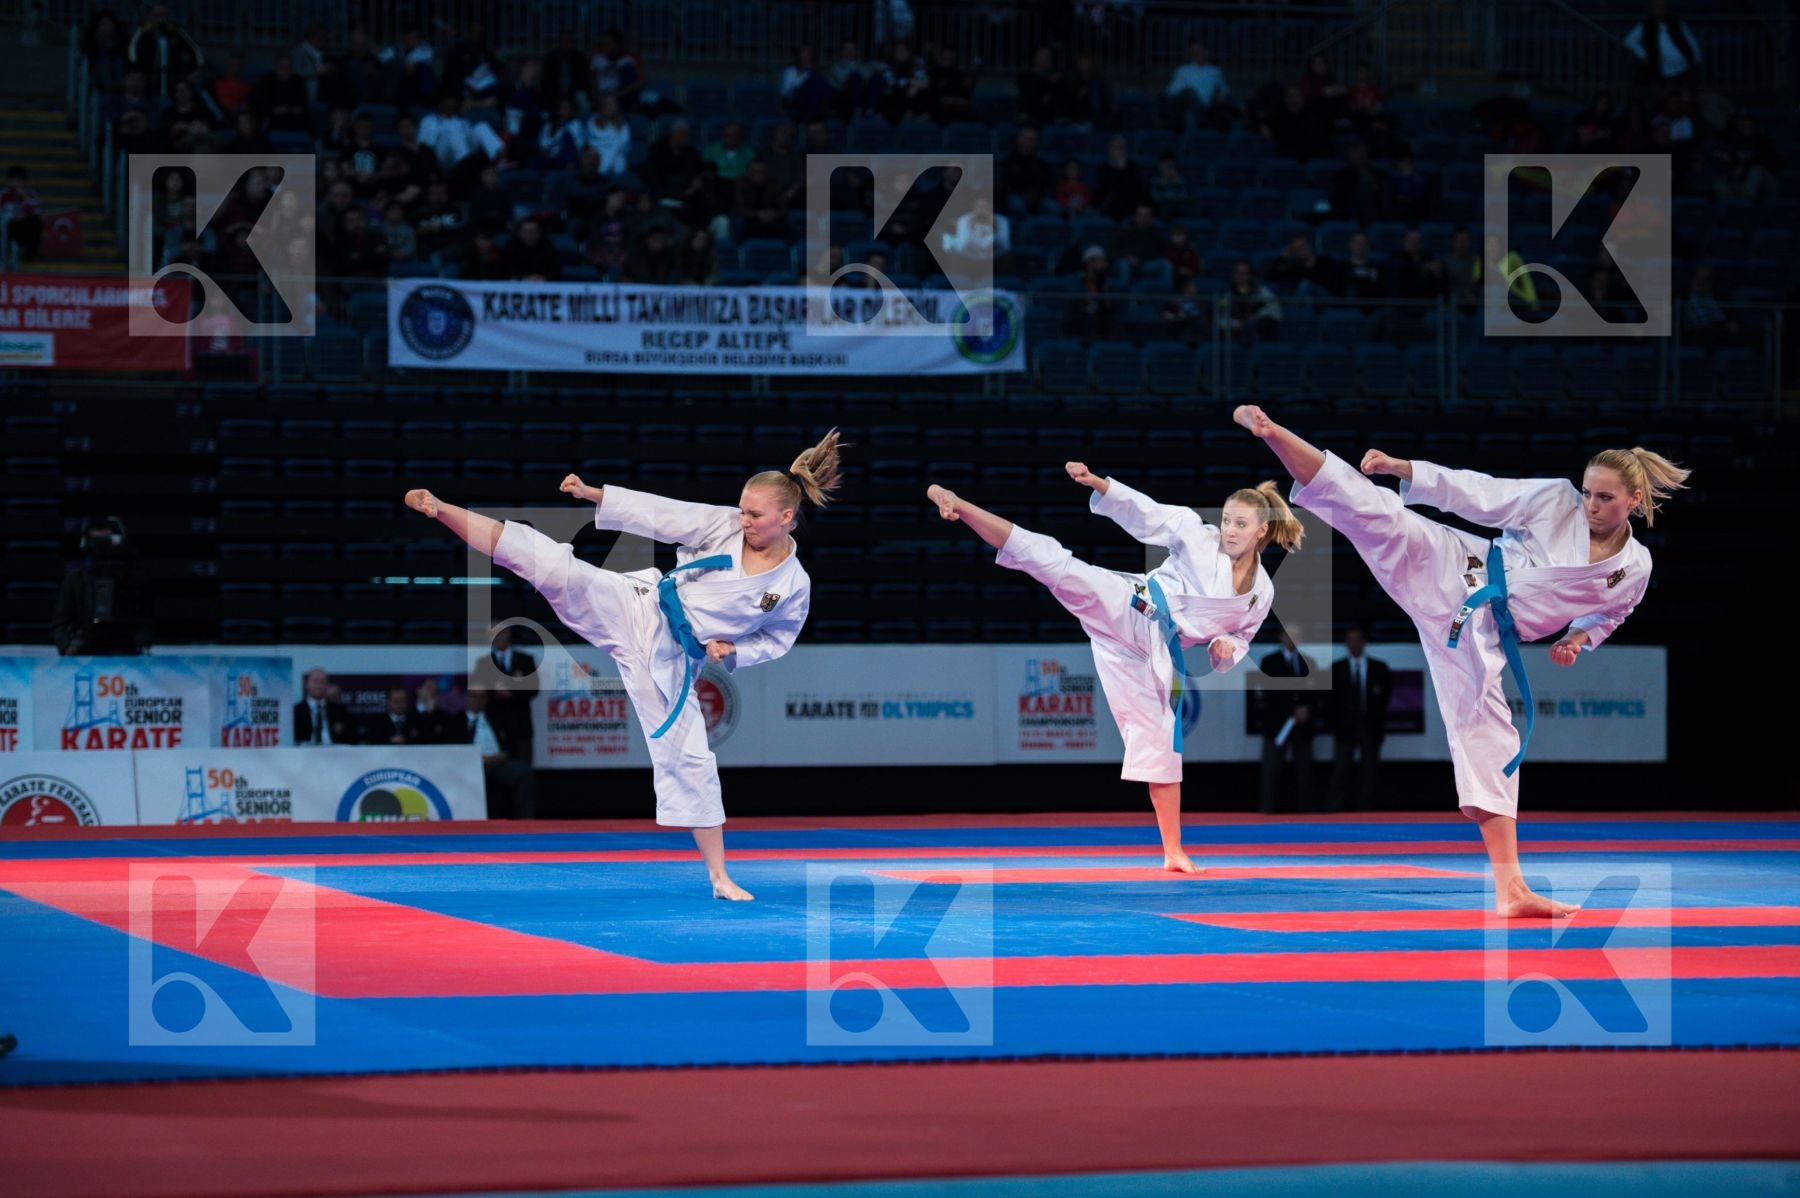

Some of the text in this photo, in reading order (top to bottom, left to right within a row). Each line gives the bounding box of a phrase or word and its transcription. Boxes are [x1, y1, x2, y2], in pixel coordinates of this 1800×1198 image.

[482, 292, 562, 321] KARATE
[568, 286, 619, 322] MİLLİ
[626, 294, 741, 324] TAKIMIMIZA
[24, 306, 92, 330] DİLERİZ
[641, 331, 790, 350] RECEP ALTEPE
[585, 352, 630, 365] BURSA
[125, 698, 182, 707] EUROPEAN
[548, 698, 628, 719] KARATE
[786, 701, 855, 718] KARATE
[882, 701, 975, 718] OLYMPICS
[1019, 695, 1094, 714] KARATE
[1558, 699, 1645, 717] OLYMPICS
[126, 710, 182, 724] SENIOR
[61, 727, 182, 750] KARATE
[221, 727, 279, 747] KARATE
[361, 770, 422, 787] EUROPEAN
[235, 789, 290, 799] EUROPEAN
[237, 801, 291, 815] SENIOR
